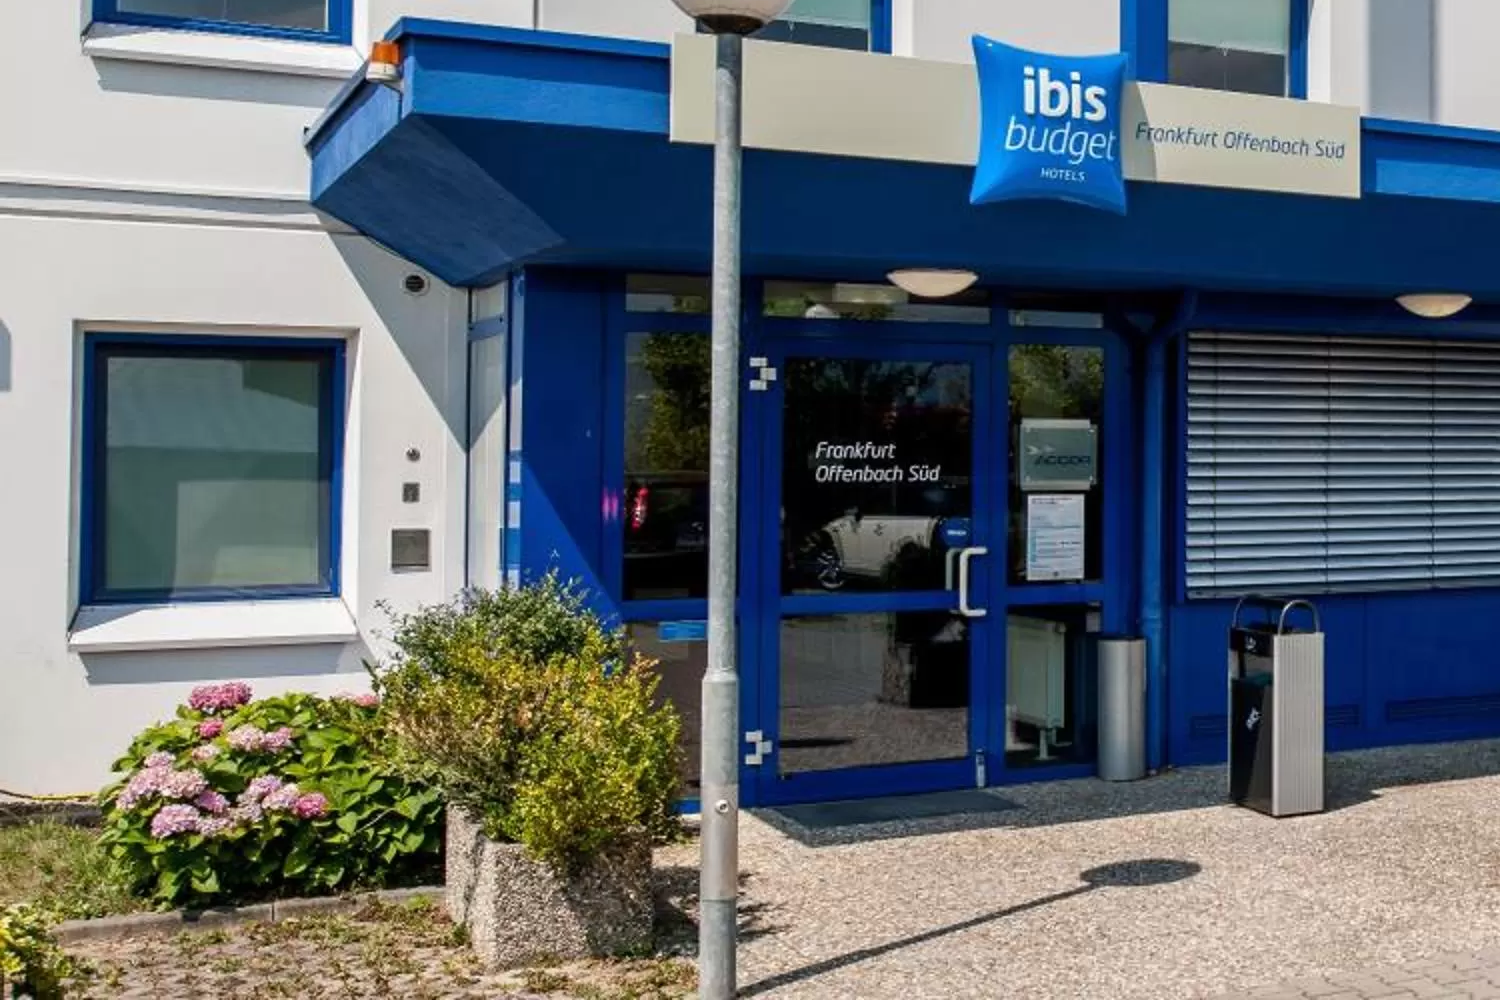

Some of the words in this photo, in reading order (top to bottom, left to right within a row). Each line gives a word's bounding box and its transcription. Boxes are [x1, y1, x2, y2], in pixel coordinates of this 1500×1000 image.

[1022, 65, 1108, 122] ibis
[1004, 115, 1118, 165] budget
[1134, 121, 1219, 150] Frankfurt
[1223, 130, 1310, 157] Offenbach
[1314, 139, 1346, 160] Süd
[1039, 166, 1087, 182] HOTELS
[815, 441, 897, 459] Frankfurt
[815, 464, 904, 482] Offenbach
[907, 464, 941, 482] Süd
